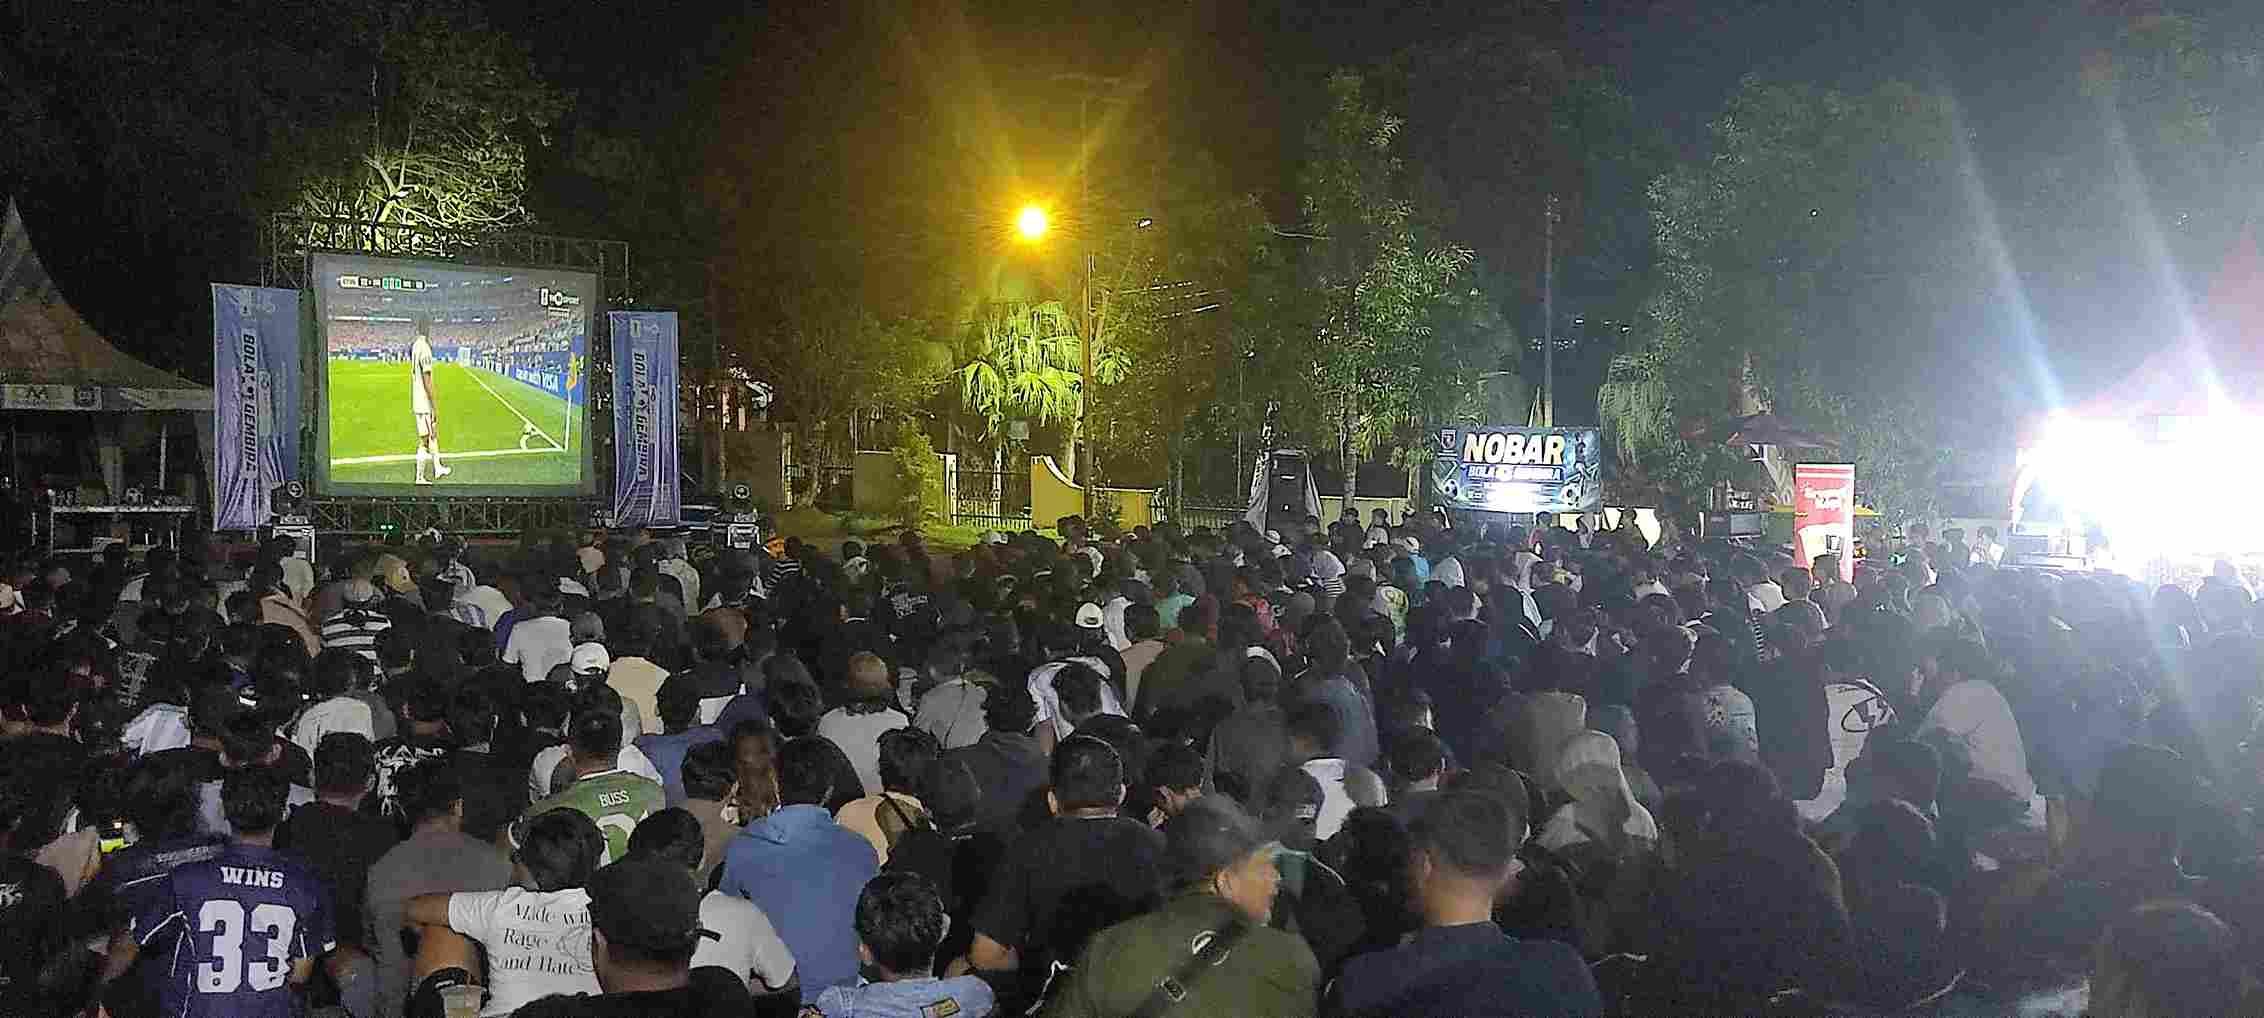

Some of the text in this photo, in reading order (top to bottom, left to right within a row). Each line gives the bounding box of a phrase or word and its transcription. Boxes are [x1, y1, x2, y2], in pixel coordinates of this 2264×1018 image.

[243, 333, 256, 374] BOLA
[542, 373, 559, 393] VISA
[1463, 433, 1566, 465] NOBAR
[599, 790, 630, 807] BUSS
[220, 866, 285, 889] WINS
[197, 899, 297, 993] 33
[504, 928, 546, 950] Rage
[502, 956, 531, 970] and
